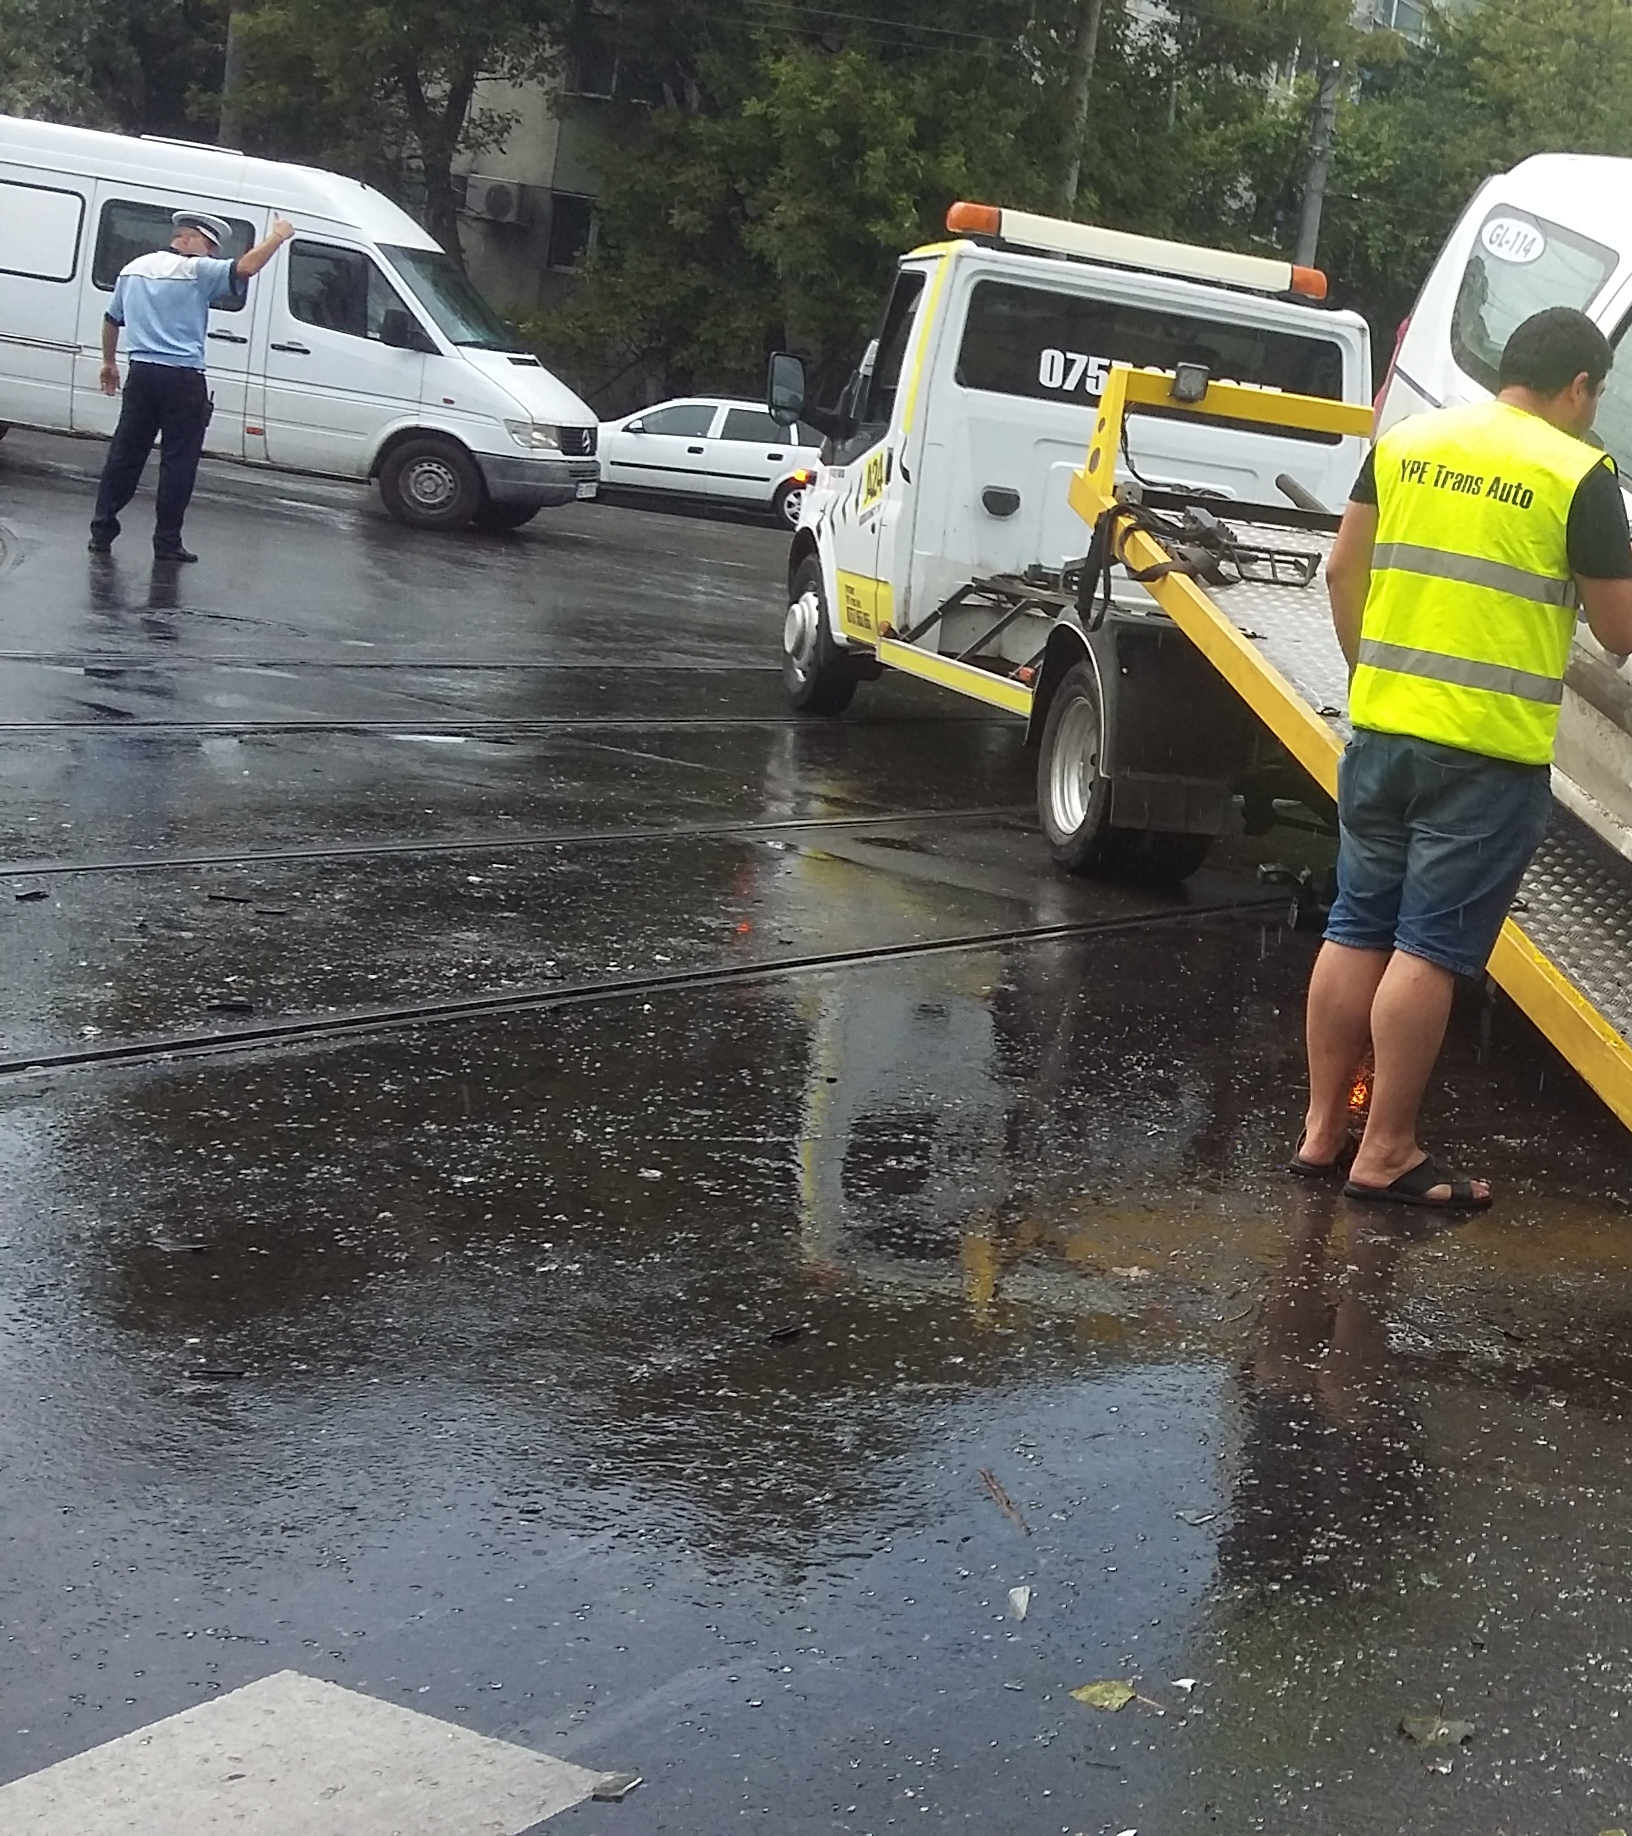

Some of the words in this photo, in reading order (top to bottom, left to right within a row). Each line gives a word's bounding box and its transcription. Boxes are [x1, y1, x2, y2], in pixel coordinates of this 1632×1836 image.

[1489, 223, 1536, 258] GL-114
[1038, 348, 1134, 396] 075
[1400, 459, 1431, 485] YPE
[1433, 464, 1484, 495] Trans
[1485, 476, 1534, 510] Auto
